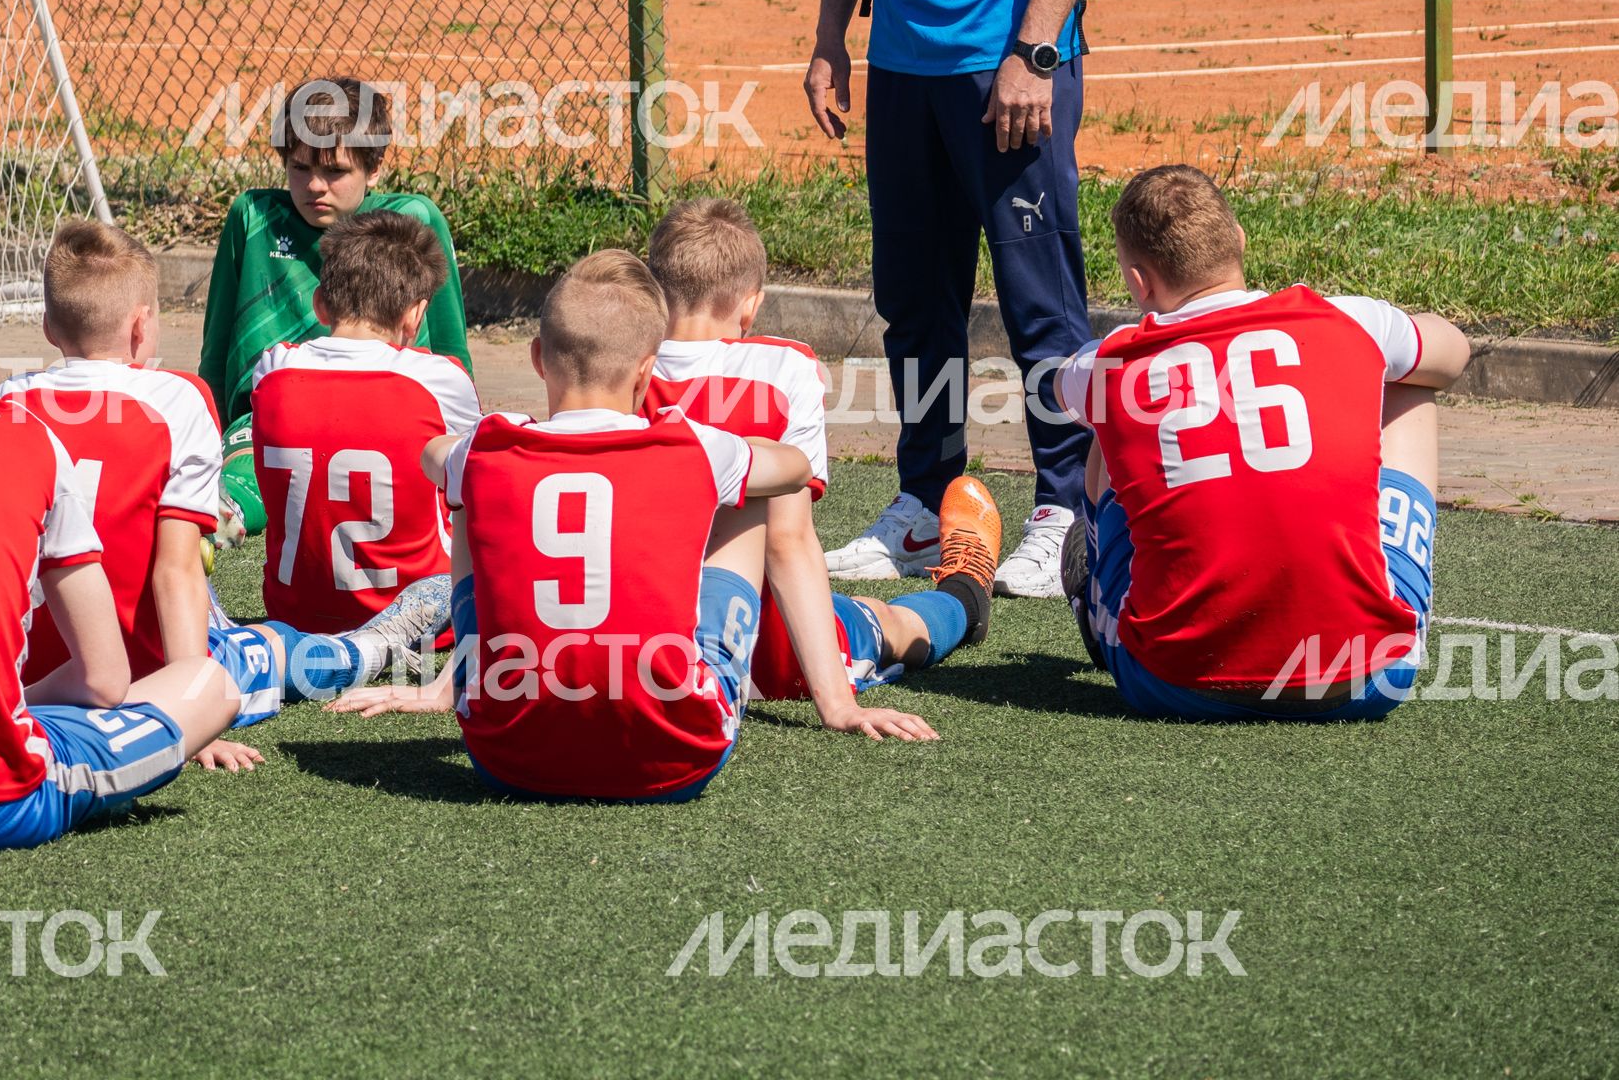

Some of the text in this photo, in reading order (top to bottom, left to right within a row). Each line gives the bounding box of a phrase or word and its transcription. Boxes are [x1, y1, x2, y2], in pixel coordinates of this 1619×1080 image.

[1148, 329, 1313, 489] 26
[263, 446, 398, 591] 72
[532, 472, 614, 629] 9
